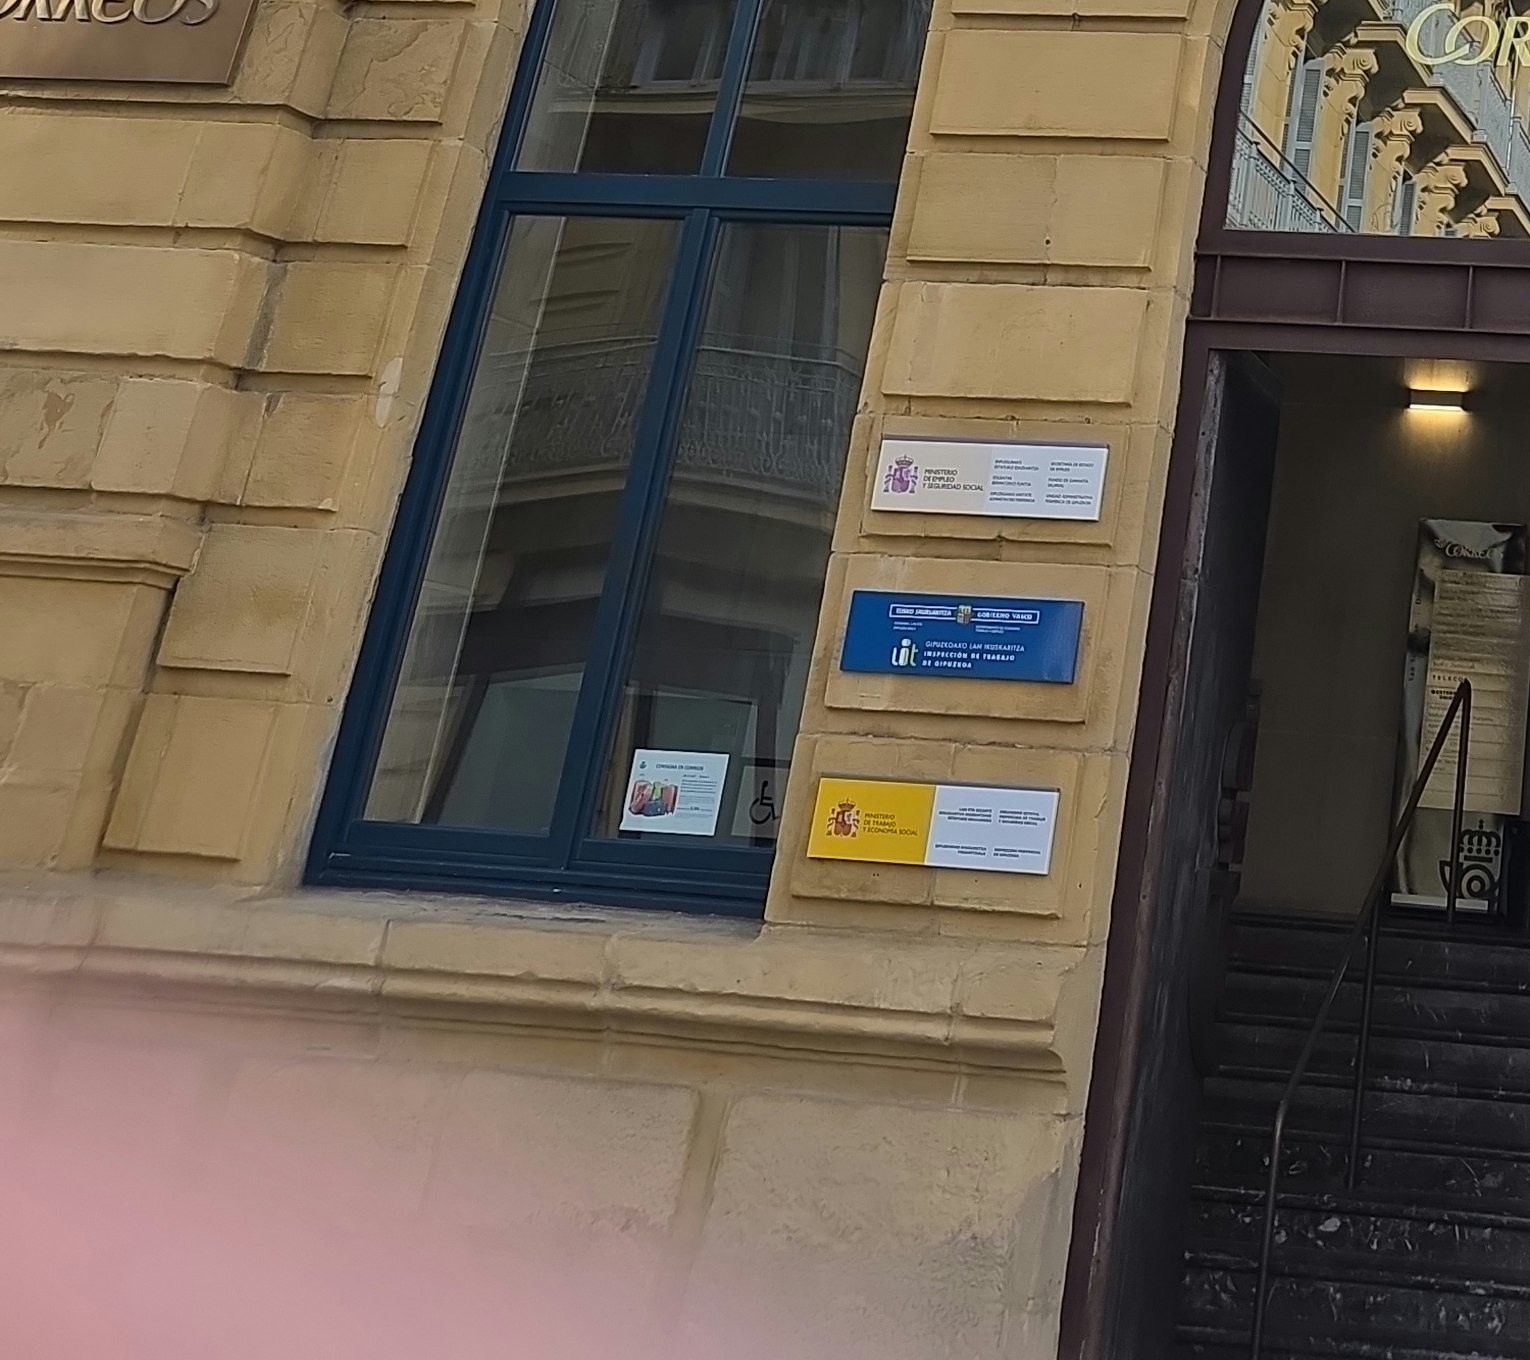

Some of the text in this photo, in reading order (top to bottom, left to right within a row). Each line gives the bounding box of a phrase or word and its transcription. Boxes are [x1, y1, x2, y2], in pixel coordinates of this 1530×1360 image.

[925, 641, 1025, 652] GIPUZKOAKO LAN IKUSKARITZA
[923, 650, 968, 659] INSPECCIÓN
[983, 653, 1015, 661] TRABAJO
